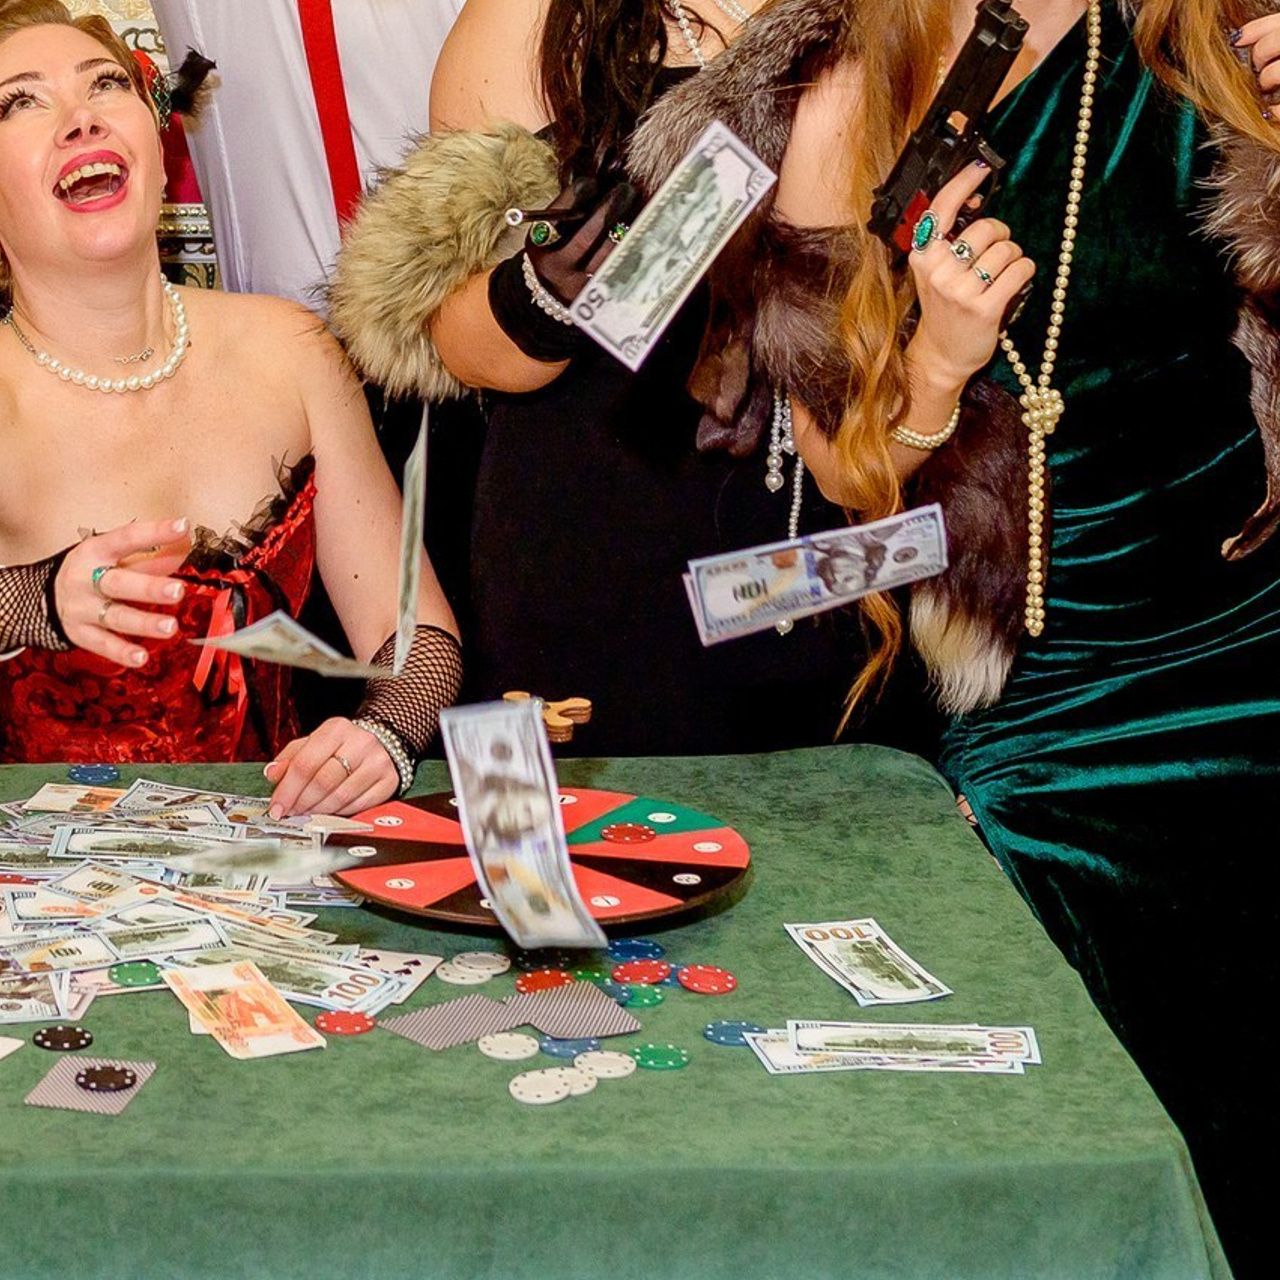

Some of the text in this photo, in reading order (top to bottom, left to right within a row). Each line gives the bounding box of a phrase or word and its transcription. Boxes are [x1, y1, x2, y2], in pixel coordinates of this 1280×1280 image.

[576, 287, 605, 321] 50
[804, 926, 873, 942] 100
[327, 973, 381, 1003] 100
[987, 1031, 1025, 1055] 100
